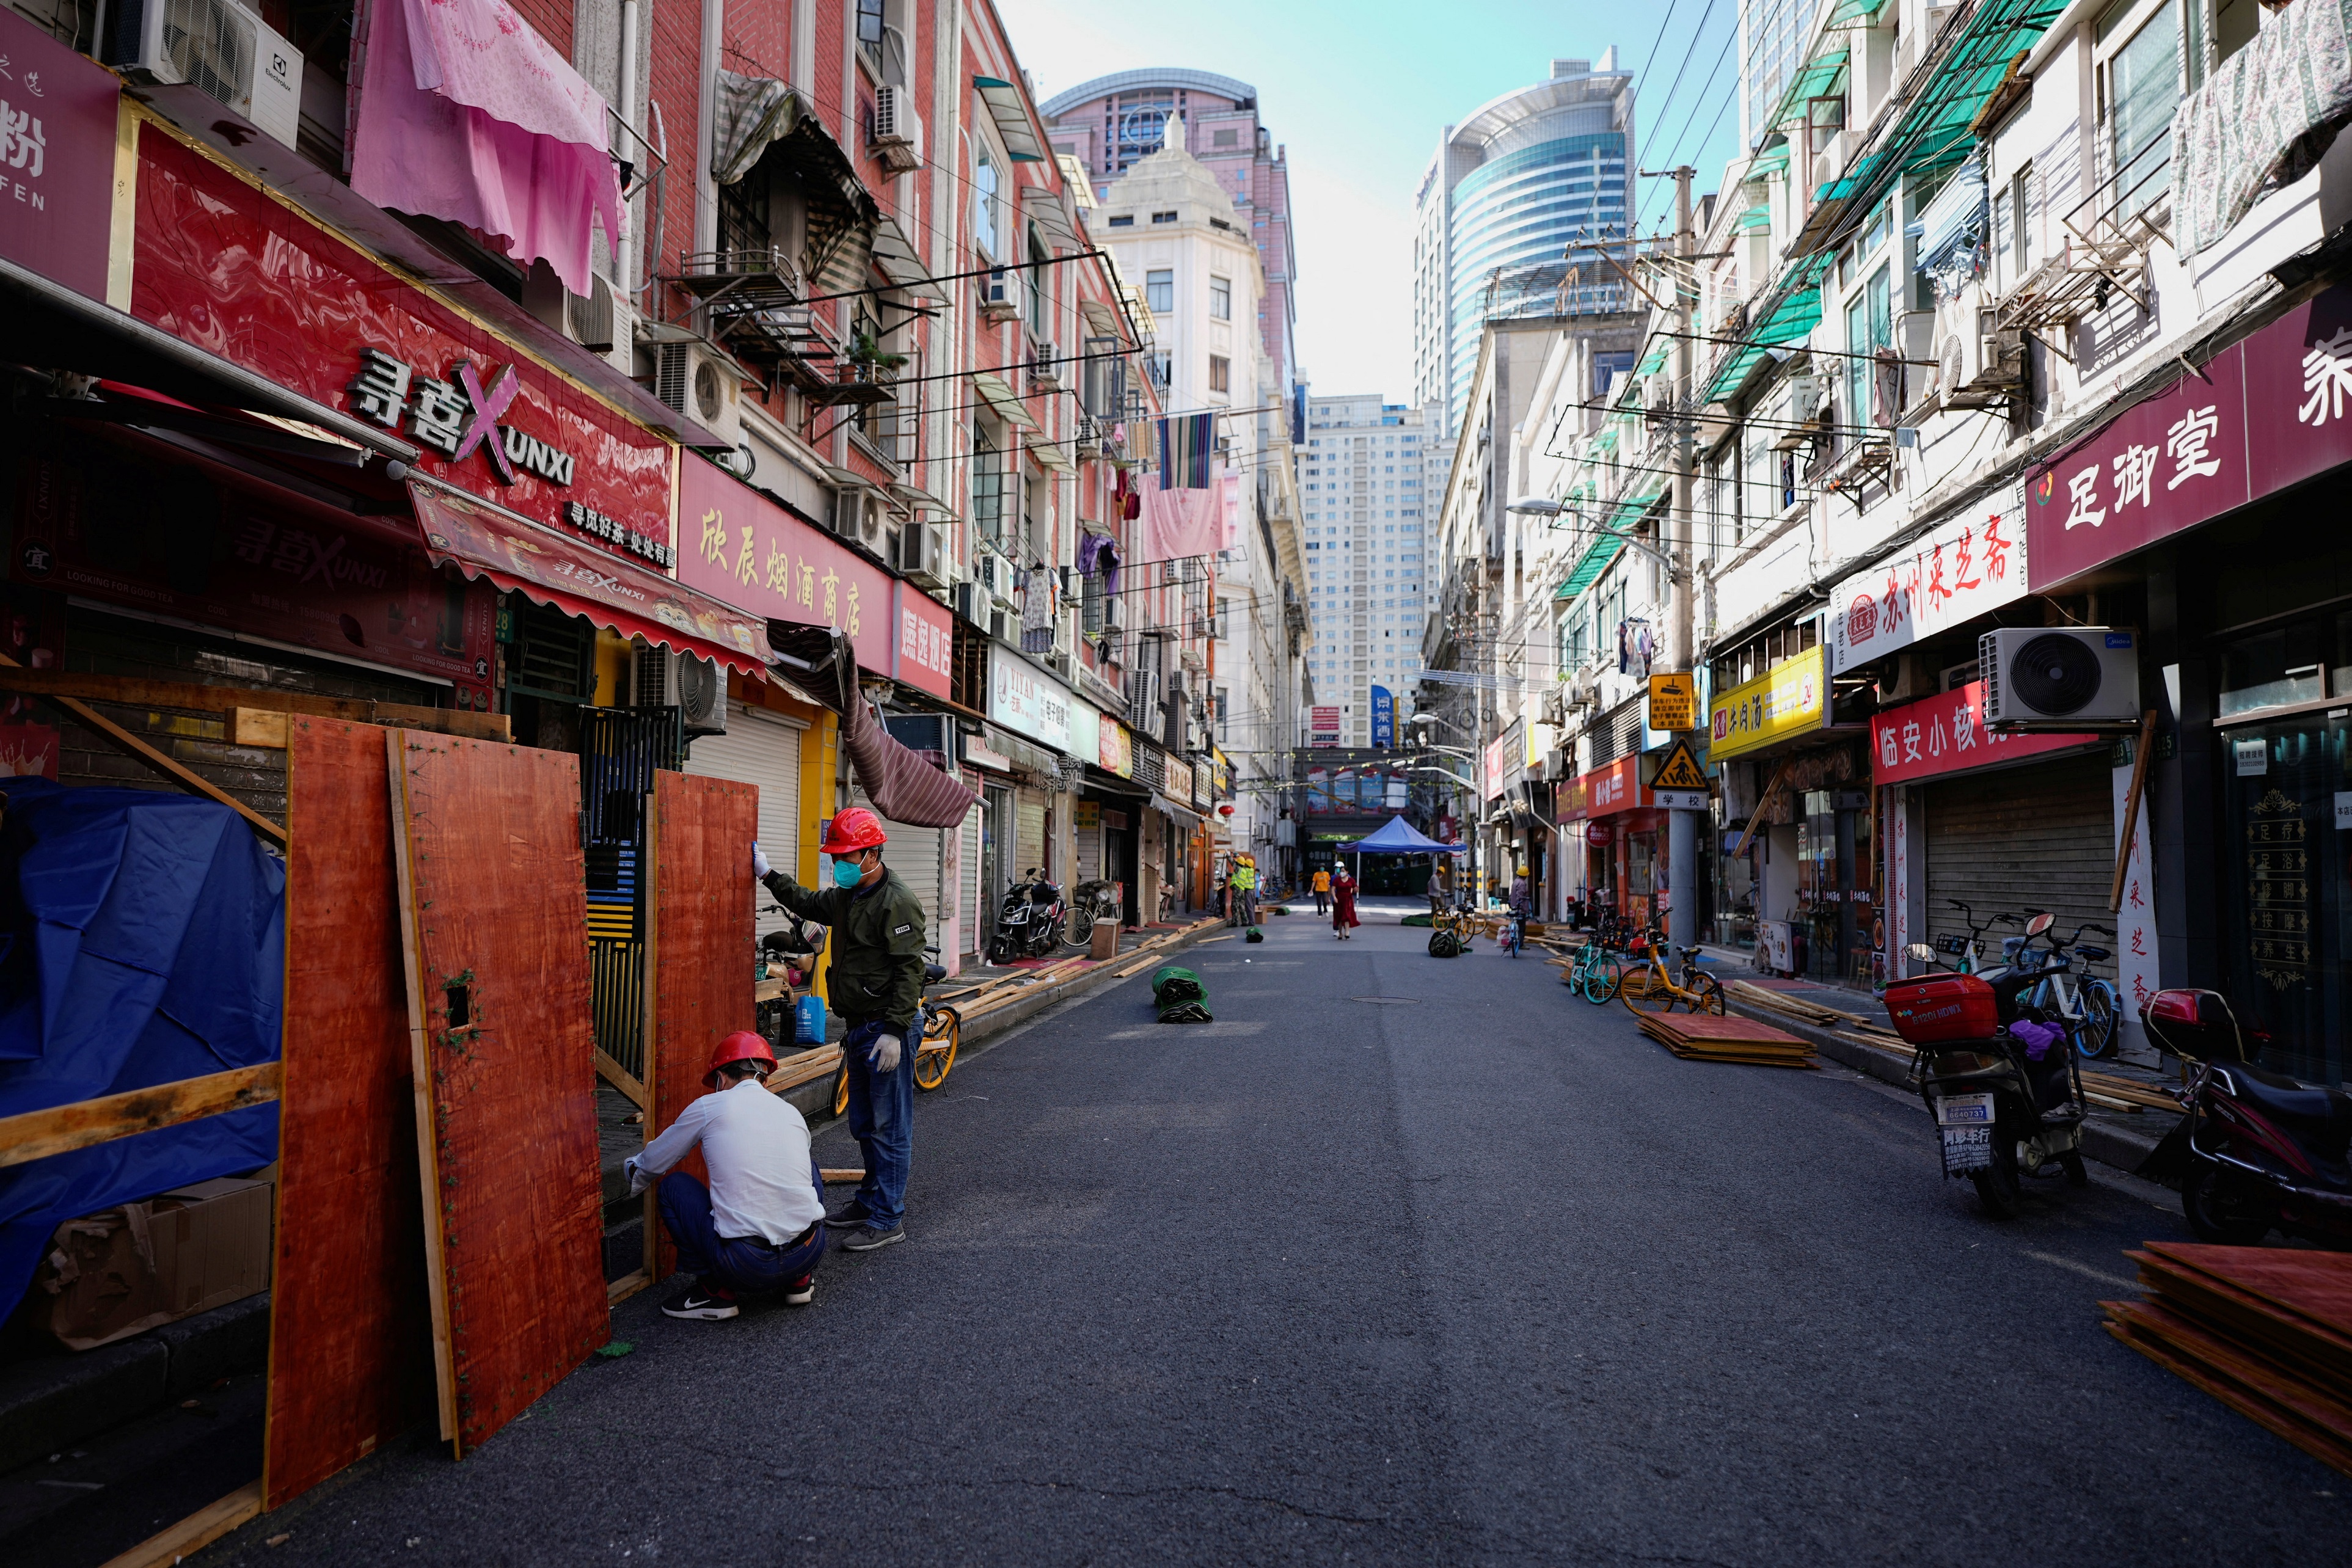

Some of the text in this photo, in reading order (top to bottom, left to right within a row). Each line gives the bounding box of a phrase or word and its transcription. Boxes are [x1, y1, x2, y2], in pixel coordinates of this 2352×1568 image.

[265, 68, 291, 93] Electrolux
[0, 99, 46, 177] 粉
[614, 291, 629, 306] SANYO
[346, 346, 575, 486] 寻喜 XUNXI
[2065, 405, 2221, 531] 足御堂
[381, 515, 397, 527] COOL
[480, 509, 495, 518] FOR
[498, 516, 518, 527] GOOD
[549, 537, 565, 545] COOL
[563, 500, 676, 569] 寻觅好茶 处处有喜
[552, 560, 595, 585] 寻喜
[593, 572, 645, 601] XUNXI
[701, 508, 860, 638] 欣辰烟酒商店
[1883, 514, 2012, 634] 苏州采芝斋
[67, 571, 173, 605] LOOKING FOR GOOD TEA
[208, 605, 228, 617] COOL
[374, 645, 390, 655] COOL
[2107, 636, 2130, 646] Midea
[412, 654, 470, 674] LOOKING FOR GOOD TEA
[1011, 668, 1035, 701] YIYAN
[1653, 704, 1690, 713] 请立即驶离
[1729, 693, 1762, 740] 牛肉汤
[2113, 743, 2124, 759] 123
[2156, 735, 2172, 751] 125
[2239, 749, 2263, 760] 招聘技师
[1663, 795, 1699, 806] 学校
[2260, 823, 2292, 841] 足疗
[2261, 853, 2293, 870] 足浴
[2124, 787, 2147, 1004] 州采芝斋
[2261, 881, 2295, 900] 修脚
[2262, 913, 2295, 930] 按摩
[2263, 941, 2296, 960] 养生
[1912, 1004, 1962, 1026] B120i HDWX
